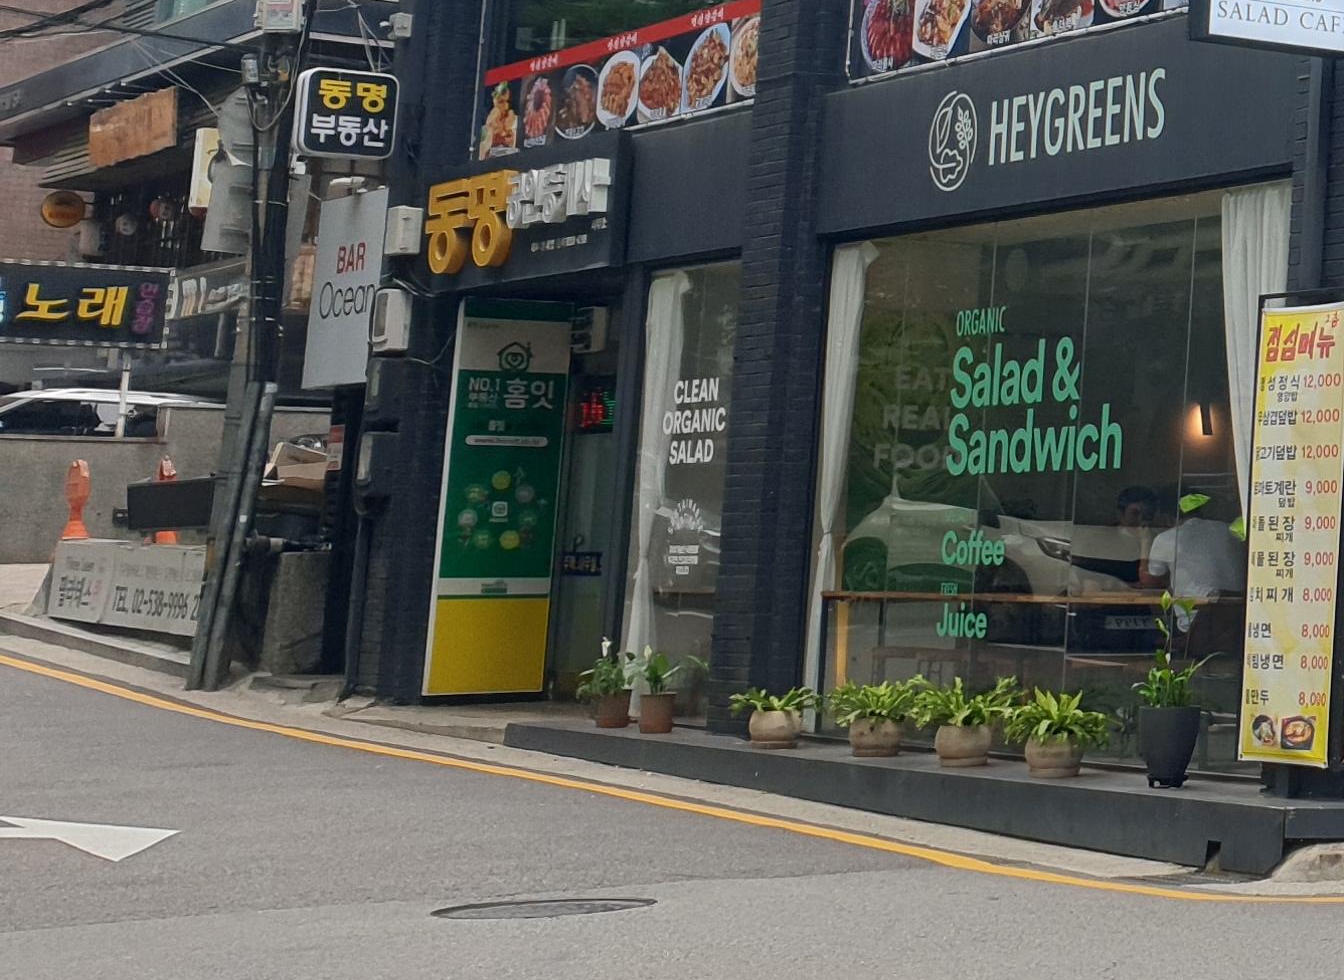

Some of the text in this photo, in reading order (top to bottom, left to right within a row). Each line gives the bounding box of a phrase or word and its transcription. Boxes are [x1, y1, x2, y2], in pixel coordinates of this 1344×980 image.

[1217, 0, 1289, 27] SALAD
[319, 78, 388, 113] 동명
[310, 113, 388, 148] 부동산
[988, 67, 1166, 167] HEYGREENS
[425, 170, 519, 274] 동명
[336, 242, 366, 275] BAR
[16, 283, 129, 327] 노래
[318, 281, 375, 320] Ocean
[956, 306, 1007, 336] ORGANIC
[1266, 321, 1336, 362] 점심메뉴
[950, 336, 1081, 409] Salad &
[1303, 373, 1341, 389] 12,000
[469, 377, 501, 392] NO.1
[503, 378, 555, 410] 홈잇
[674, 377, 719, 404] CLEAN
[662, 407, 726, 435] ORGANIC
[1301, 408, 1340, 424] 12,000
[669, 438, 714, 464] SALAD
[946, 403, 1123, 477] Sandwich
[1301, 444, 1339, 460] 12,000
[1305, 480, 1338, 496] 9,000
[1304, 516, 1336, 531] 9,000
[941, 530, 1005, 566] Coffee
[1304, 551, 1335, 568] 9,000
[1302, 587, 1333, 603] 8,000
[936, 601, 988, 639] Juice
[1301, 623, 1330, 639] 8,000
[1300, 655, 1329, 671] 8,000
